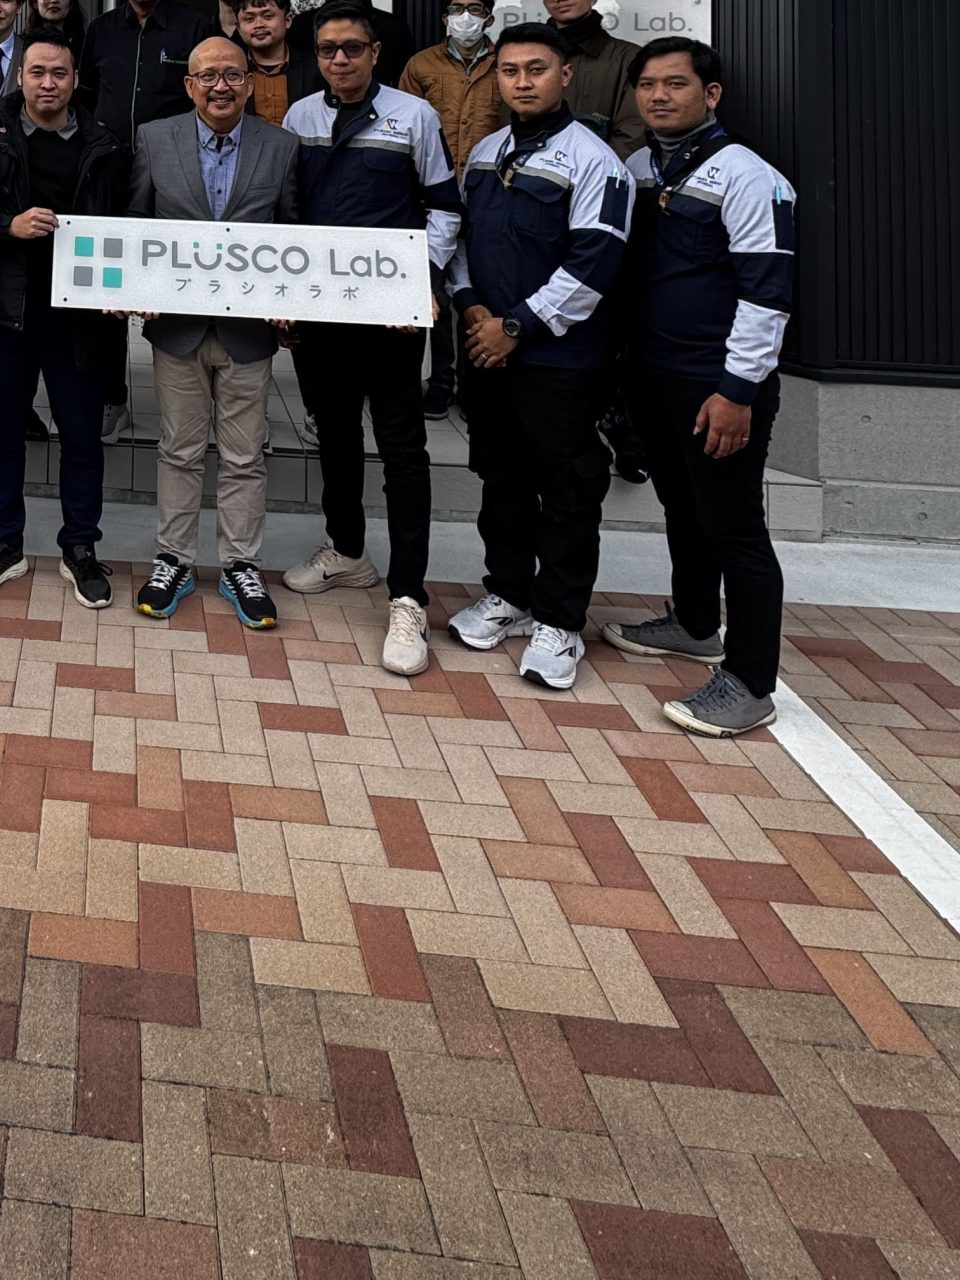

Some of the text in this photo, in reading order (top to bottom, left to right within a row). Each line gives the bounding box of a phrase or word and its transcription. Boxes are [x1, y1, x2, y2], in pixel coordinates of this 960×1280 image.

[634, 12, 693, 32] Lab.
[329, 248, 407, 279] Lab.
[174, 277, 360, 301] プラシオラボ
